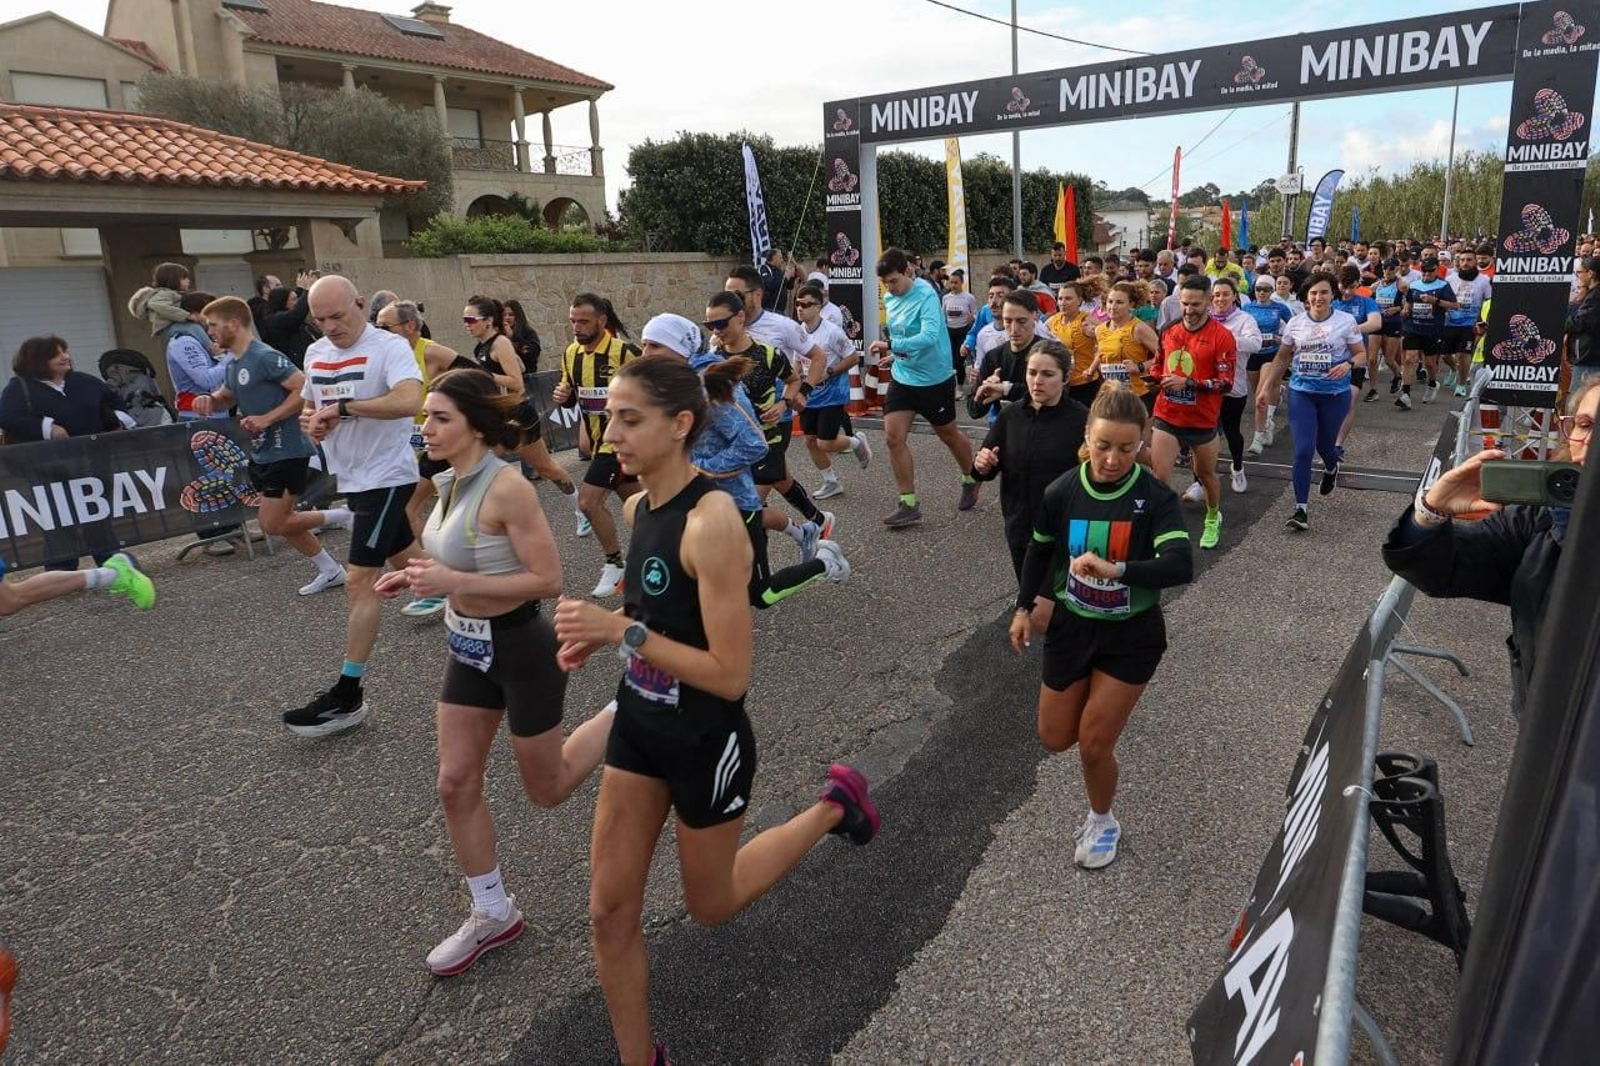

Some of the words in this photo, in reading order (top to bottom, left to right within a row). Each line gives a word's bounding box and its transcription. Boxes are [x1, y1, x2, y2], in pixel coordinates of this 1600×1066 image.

[1300, 20, 1493, 85] MINIBAY
[1059, 59, 1201, 112] MINIBAY
[871, 90, 979, 133] MINIBAY
[1508, 141, 1587, 162] MINIBAY
[827, 193, 860, 205] MINIBAY
[829, 267, 861, 278] MINIBAY
[1496, 257, 1572, 273] MINIBAY
[1486, 364, 1559, 382] MINIBAY
